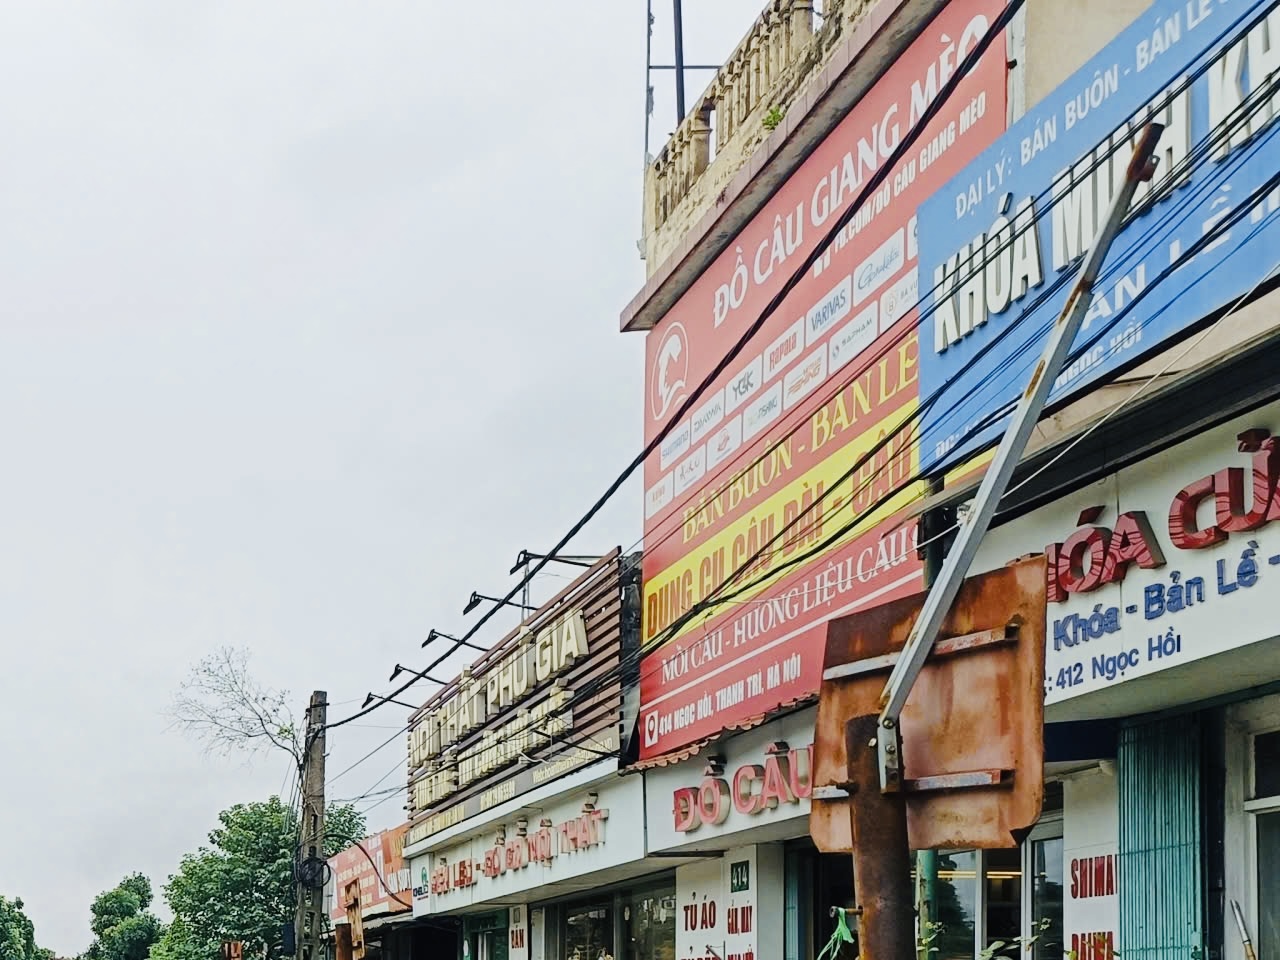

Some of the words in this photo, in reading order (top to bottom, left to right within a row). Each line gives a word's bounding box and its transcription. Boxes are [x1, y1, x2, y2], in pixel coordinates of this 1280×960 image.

[920, 127, 956, 173] GIANG
[959, 92, 986, 136] MÈO
[956, 185, 982, 219] ĐẠI
[1021, 114, 1057, 167] BÁN
[1065, 64, 1118, 132] BUÔN
[1135, 15, 1182, 74] BÁN
[714, 246, 748, 328] ĐỒ
[753, 203, 804, 285] CÂU
[810, 103, 900, 228] GIANG
[909, 14, 989, 130] MÈO
[811, 287, 847, 332] VARIVAS
[934, 192, 1045, 353] KHÓA
[811, 370, 871, 452] BÁN
[1046, 505, 1167, 602] ÓA
[1053, 604, 1120, 650] Khóa
[1144, 571, 1205, 620] Bản
[1216, 540, 1259, 595] Lề
[673, 703, 695, 730] NGỌC
[716, 680, 744, 711] THANH
[767, 661, 780, 690] HÀ
[783, 653, 801, 685] NỘI
[1056, 662, 1083, 691] 412
[1092, 648, 1139, 680] Ngọc
[1147, 627, 1181, 661] Hồi
[673, 755, 730, 833] ĐỒ
[733, 741, 814, 815] CÂU
[1071, 854, 1118, 899] SHIMA
